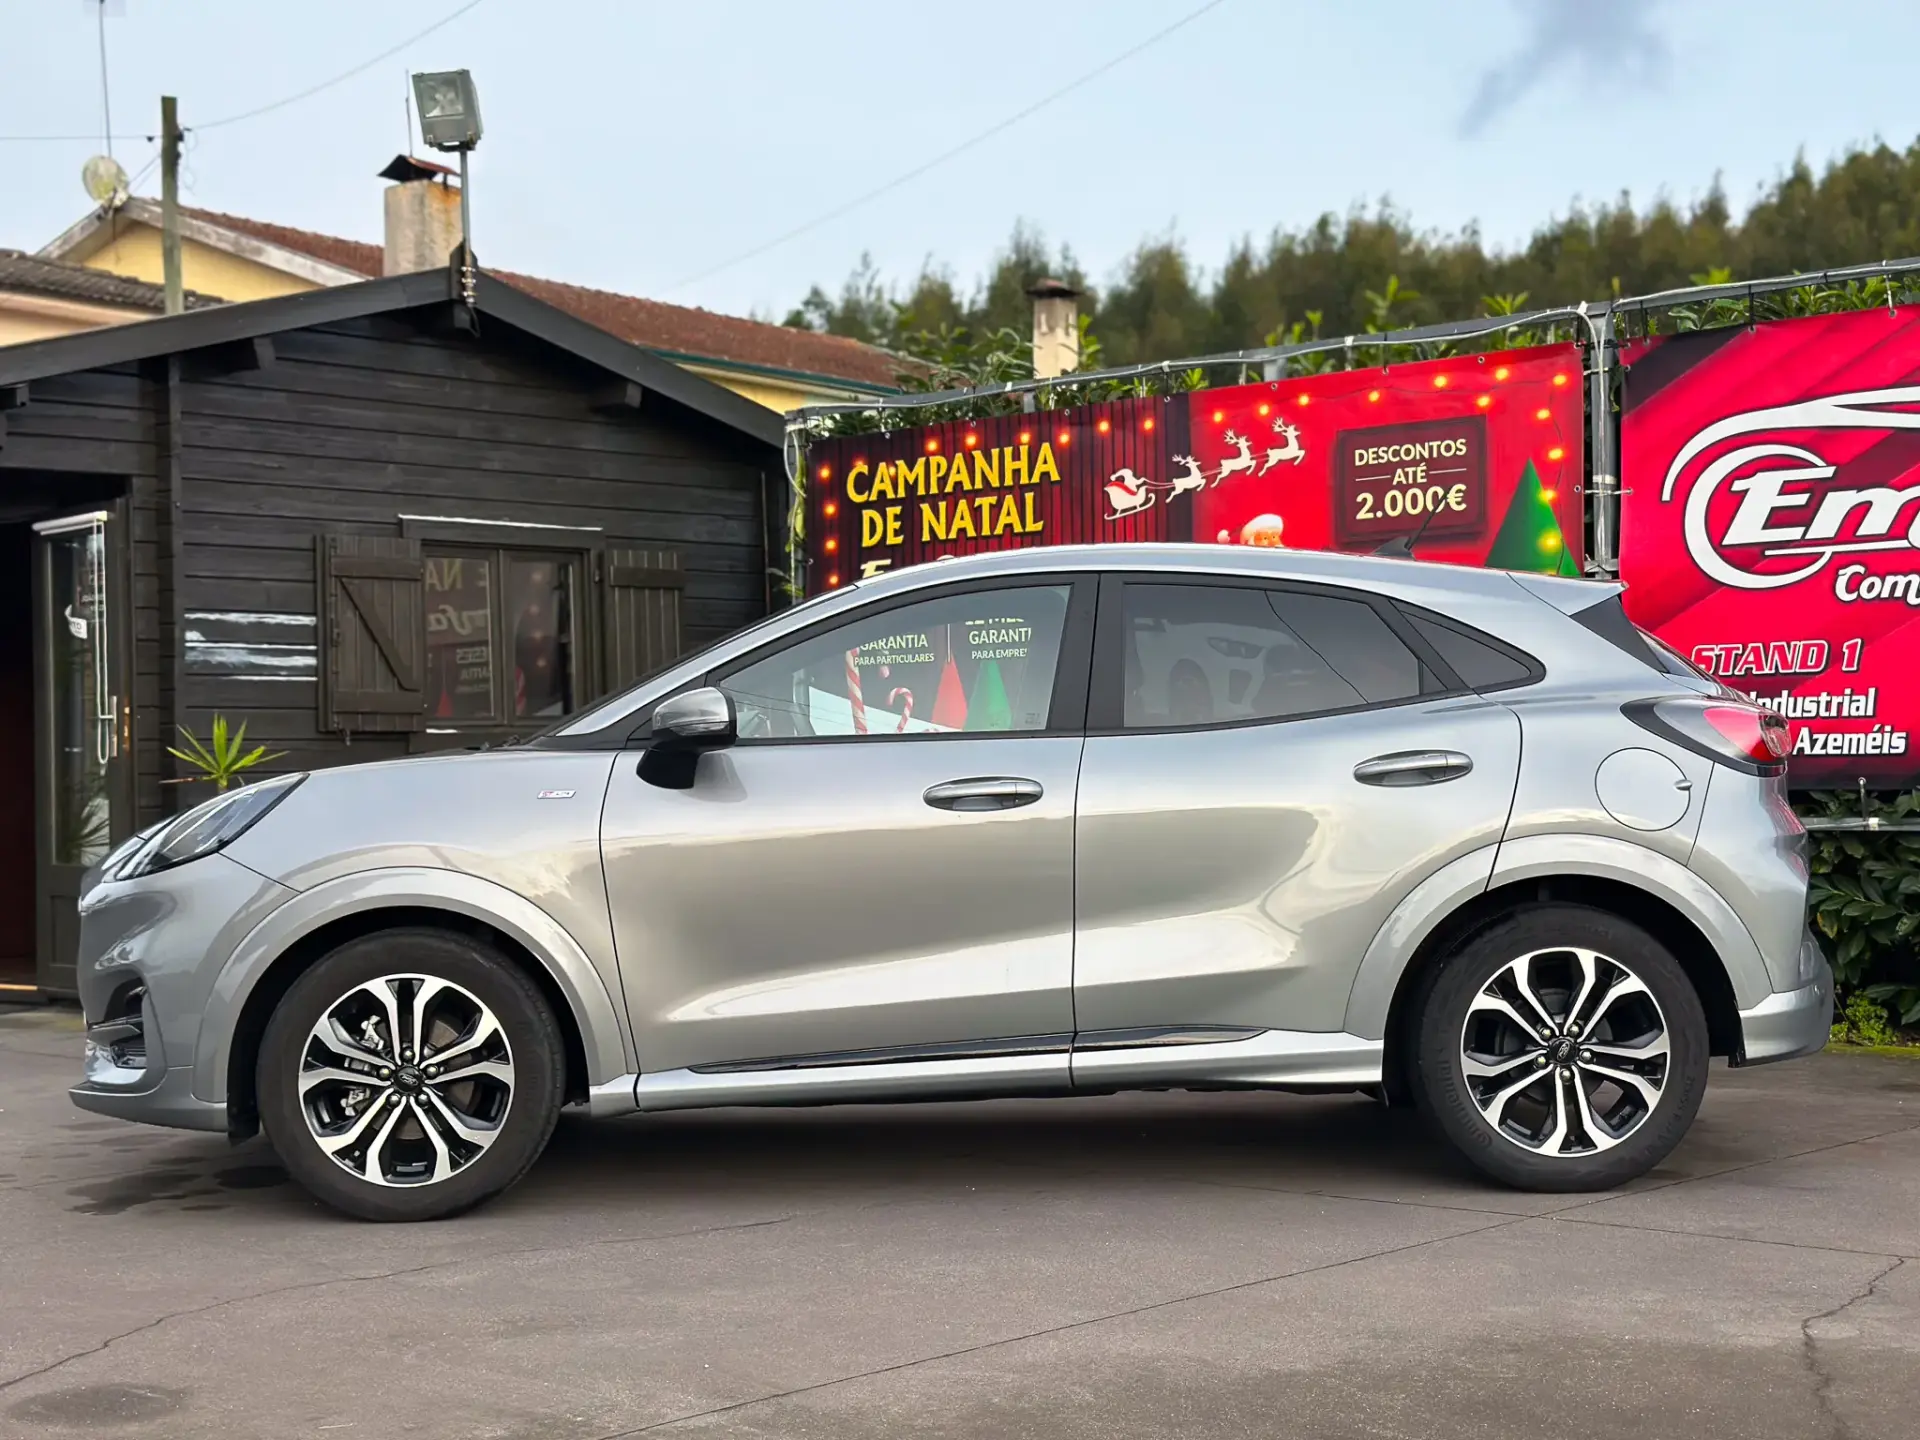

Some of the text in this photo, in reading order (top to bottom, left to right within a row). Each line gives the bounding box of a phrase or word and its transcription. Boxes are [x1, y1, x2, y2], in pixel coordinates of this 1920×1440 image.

[1355, 438, 1467, 466] DESCONTOS
[847, 442, 1061, 503] CAMPANHA
[1392, 461, 1428, 486] ATÉ
[1355, 483, 1467, 520] 2.000€
[861, 492, 1044, 547] DE NATAL
[855, 653, 935, 666] PARA PARTICULARES
[971, 648, 1028, 660] PARA EMPRE
[1692, 638, 1863, 676] STAND 1
[1792, 724, 1907, 755] Azeméis
